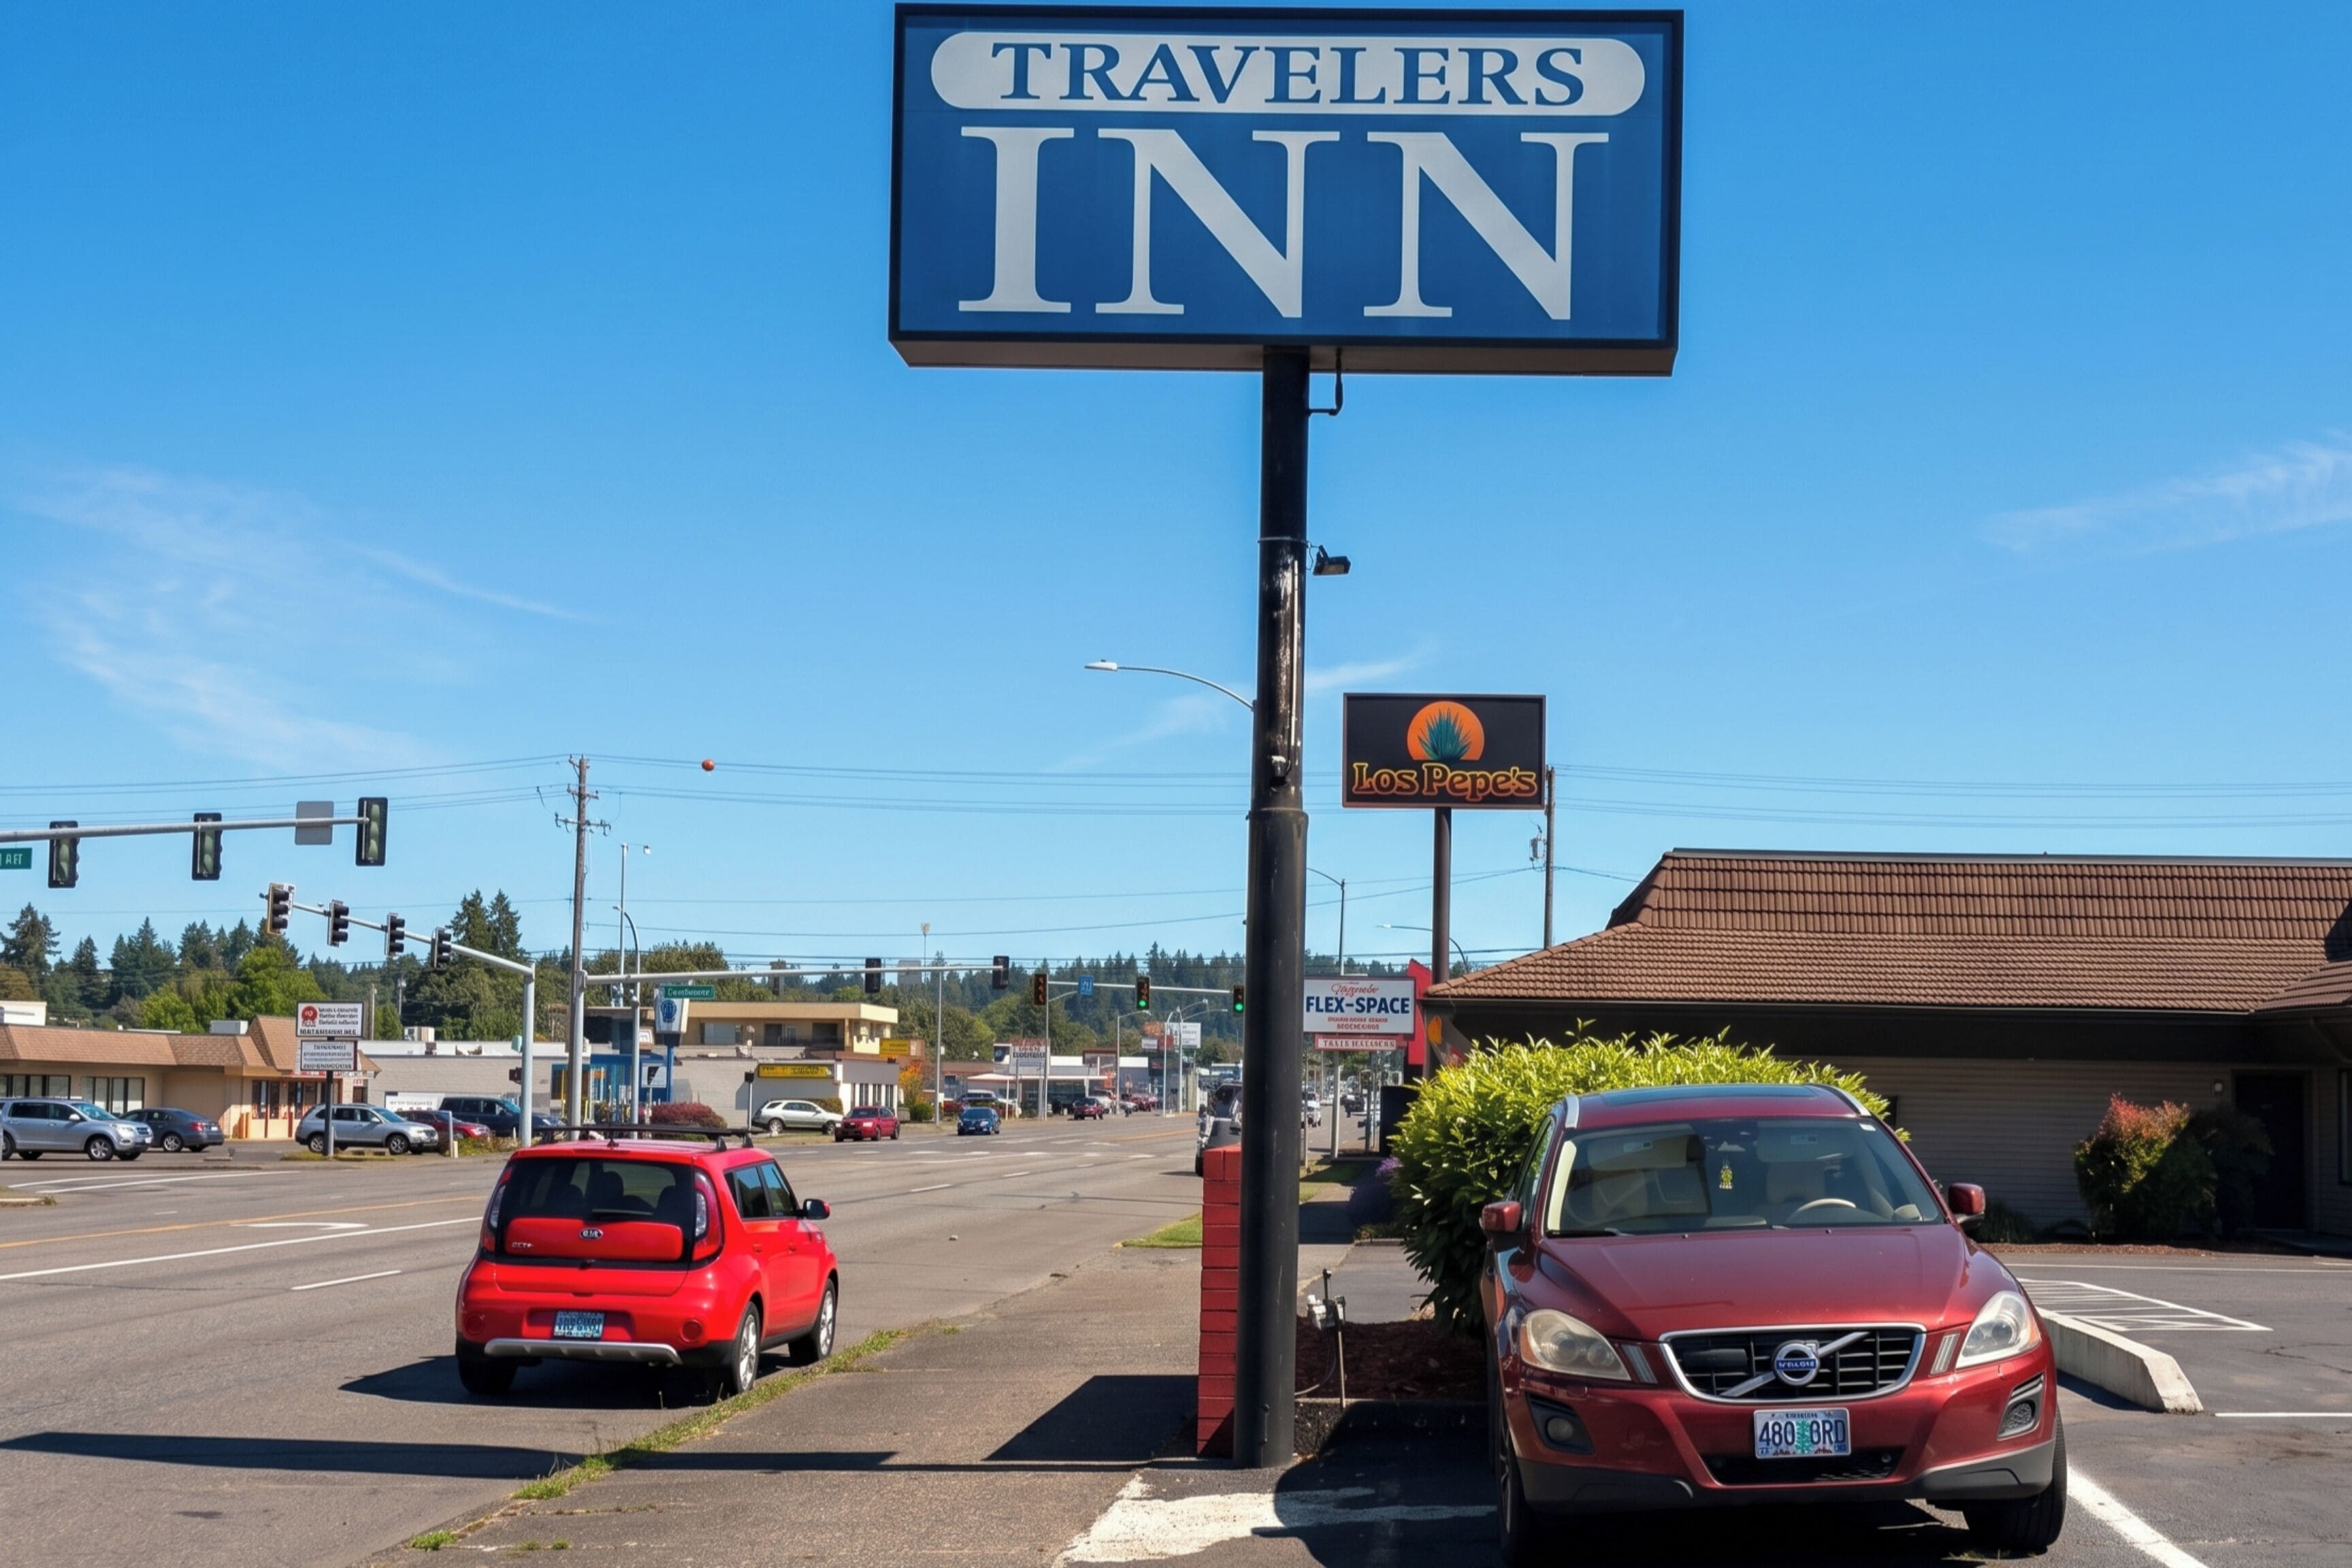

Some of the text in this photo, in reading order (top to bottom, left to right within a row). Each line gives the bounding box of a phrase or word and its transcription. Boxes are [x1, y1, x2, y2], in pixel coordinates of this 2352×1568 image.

[991, 42, 1584, 106] TRAVELERS
[958, 126, 1610, 321] INN
[1352, 762, 1539, 802] Los Pepe's
[1305, 996, 1411, 1014] FLEX-SPACE
[1759, 1420, 1796, 1447] 480
